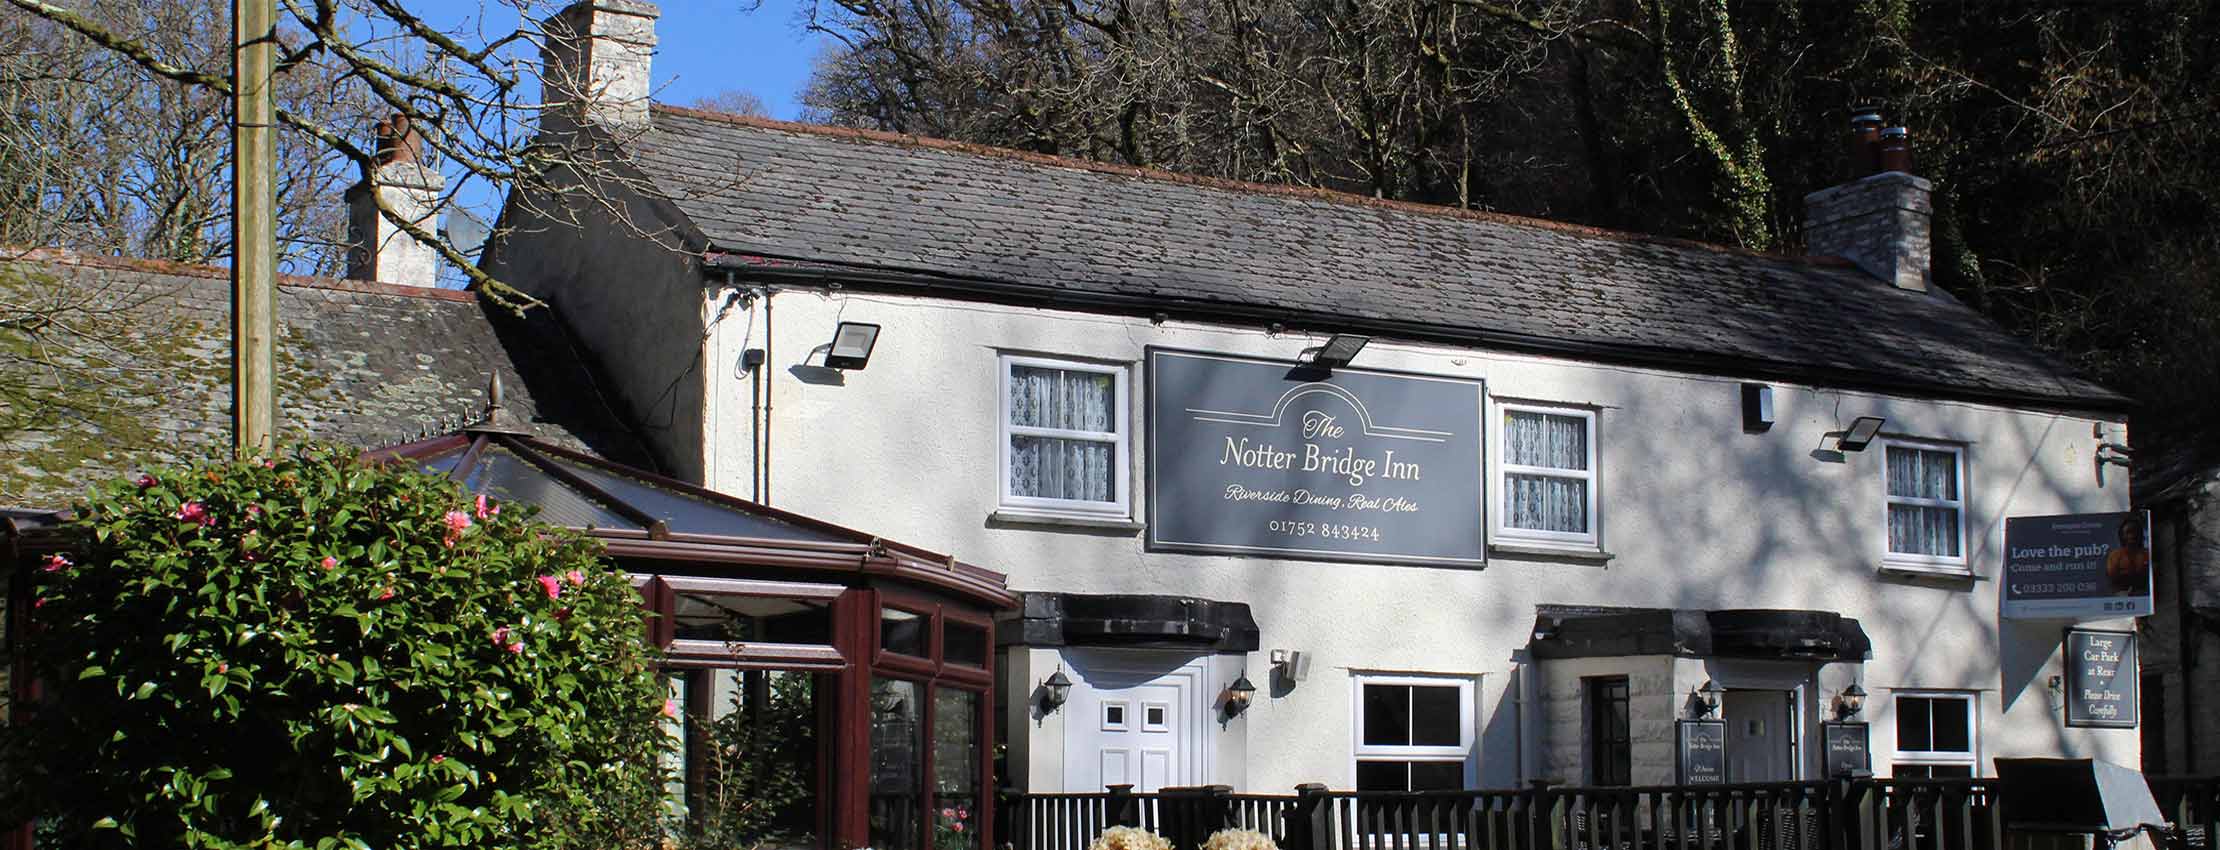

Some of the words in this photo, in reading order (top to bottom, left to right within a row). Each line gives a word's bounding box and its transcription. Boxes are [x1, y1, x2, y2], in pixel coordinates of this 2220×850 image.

[1302, 410, 1344, 439] The
[1220, 437, 1296, 470] Notter
[1303, 444, 1375, 486] Bridge
[1382, 450, 1420, 481] Inn
[1224, 484, 1290, 504] Riverside
[1347, 494, 1380, 511] Real
[1382, 499, 1419, 513] Ales
[1269, 520, 1315, 536] 01752
[1322, 524, 1380, 541] 843424
[2012, 546, 2045, 559] Love
[2048, 545, 2071, 557] the
[2074, 543, 2109, 559] pub?
[2010, 562, 2042, 572] Come
[2043, 561, 2064, 571] and
[2065, 562, 2084, 571] run
[2090, 635, 2112, 650] Large
[2084, 650, 2100, 661] Car
[2101, 651, 2119, 662] Park
[2088, 668, 2096, 676] at
[2097, 665, 2116, 676] Rear
[2084, 689, 2103, 700] Please
[2104, 689, 2120, 701] Drive
[2089, 703, 2117, 719] Carefully
